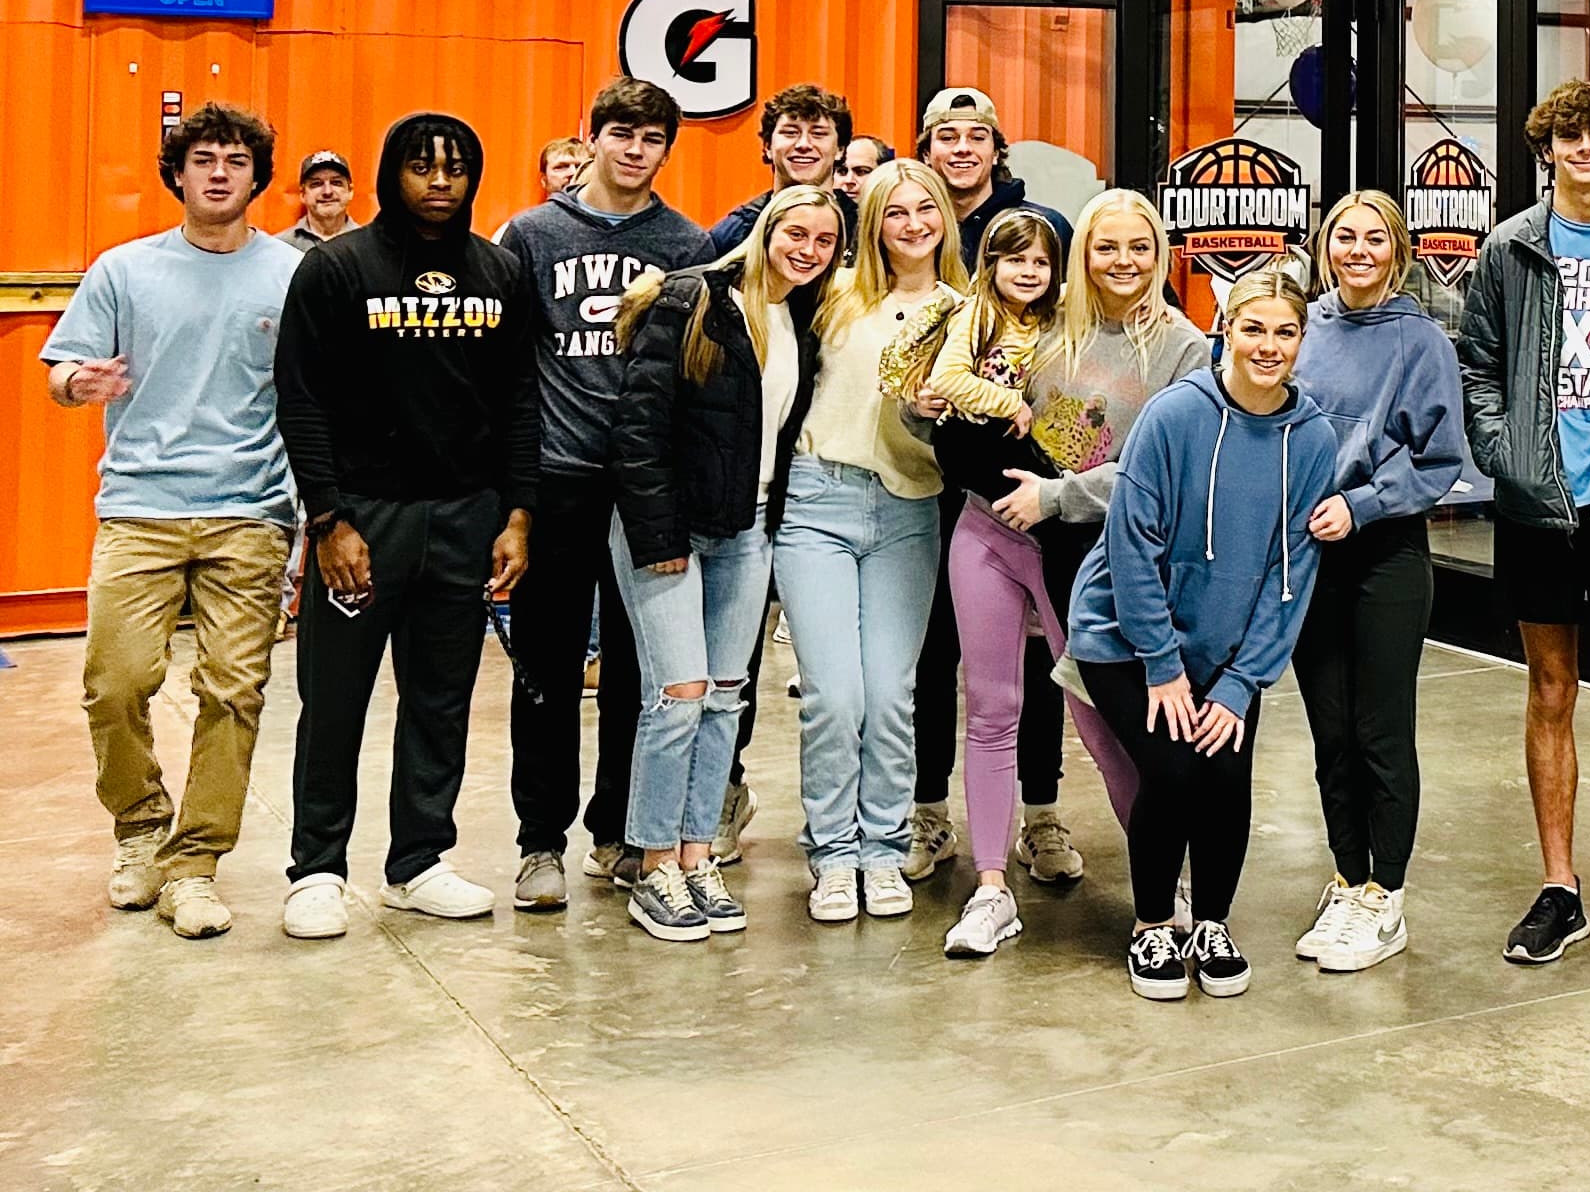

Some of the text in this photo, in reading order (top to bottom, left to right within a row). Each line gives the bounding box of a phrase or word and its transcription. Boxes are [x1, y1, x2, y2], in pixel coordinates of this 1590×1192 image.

[1163, 188, 1307, 230] COURTROOM
[1407, 189, 1490, 233] COURTROOM
[1192, 236, 1279, 249] BASKETBALL
[1422, 238, 1473, 252] BASKETBALL
[366, 296, 503, 329] MIZZOU
[554, 330, 617, 356] RANG
